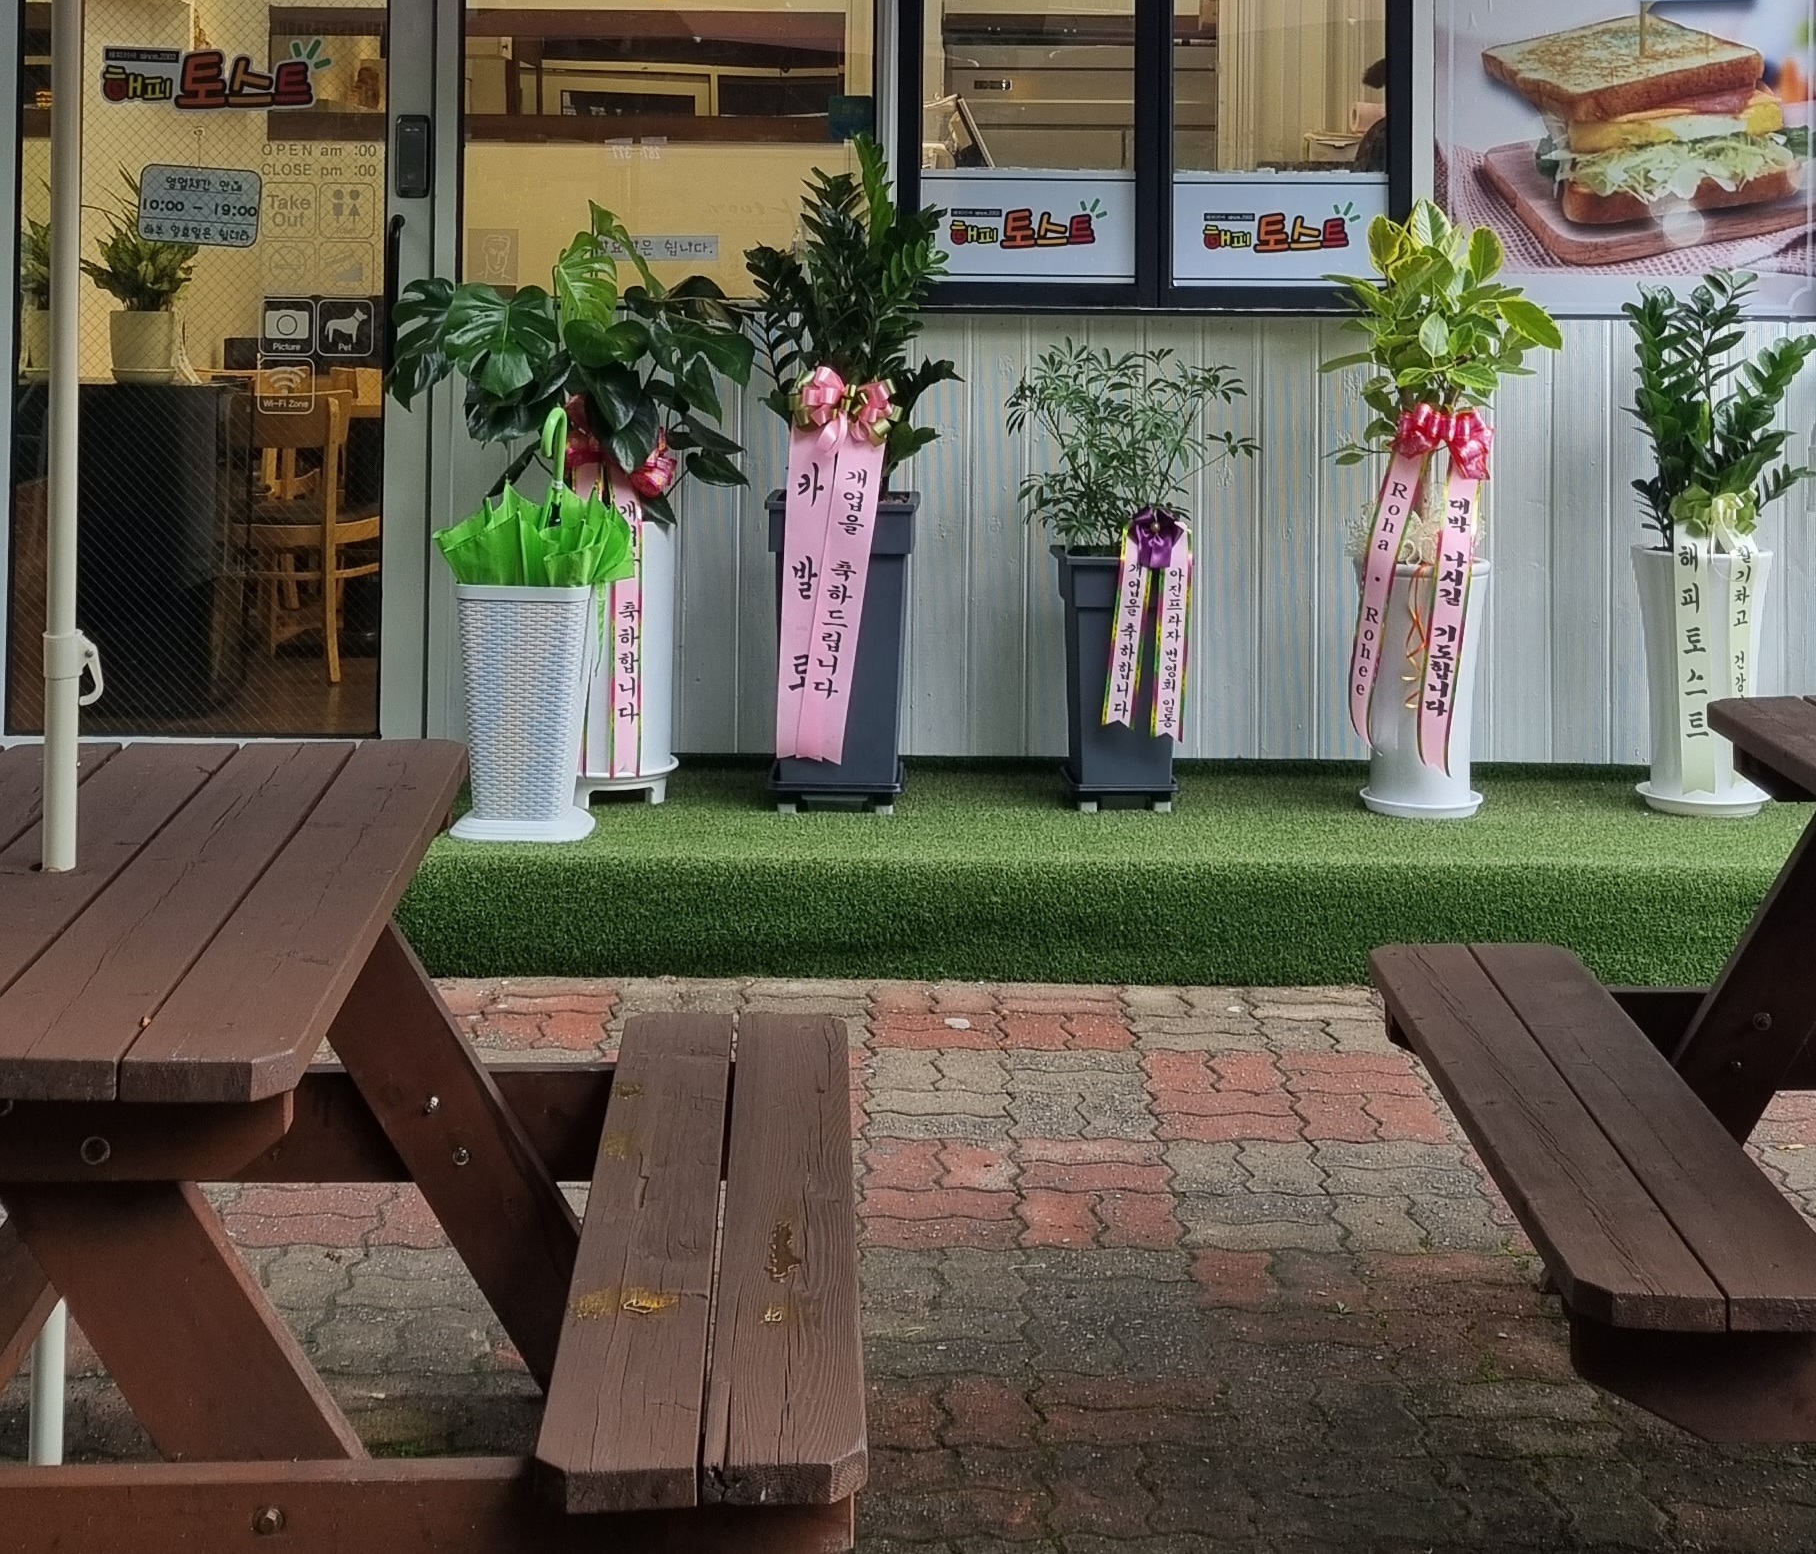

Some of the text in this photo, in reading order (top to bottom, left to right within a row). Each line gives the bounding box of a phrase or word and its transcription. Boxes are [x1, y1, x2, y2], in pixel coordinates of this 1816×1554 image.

[103, 49, 314, 109] 해피 토스트
[261, 143, 377, 157] OPEN am :00
[261, 162, 377, 178] CLOSE pm :00
[165, 176, 212, 192] 영업시간
[267, 194, 311, 211] Take
[142, 198, 185, 212] 10:00
[213, 202, 258, 218] 19:00
[271, 211, 305, 227] Out
[950, 209, 1096, 249] 해피 토스트
[1203, 212, 1349, 253] 해피 토스트
[272, 342, 301, 351] Picture
[337, 342, 352, 352] Pet
[288, 399, 309, 409] Zone
[1376, 481, 1409, 552] Roha
[812, 467, 869, 700] 개업을 축하드립니다
[1425, 498, 1471, 718] 대박 나시길 기도합니다
[1112, 563, 1142, 720] 개업을 축하합니다
[1355, 606, 1380, 697] Rohee
[618, 600, 641, 725] 축하합니다
[1161, 647, 1178, 694] 번영회
